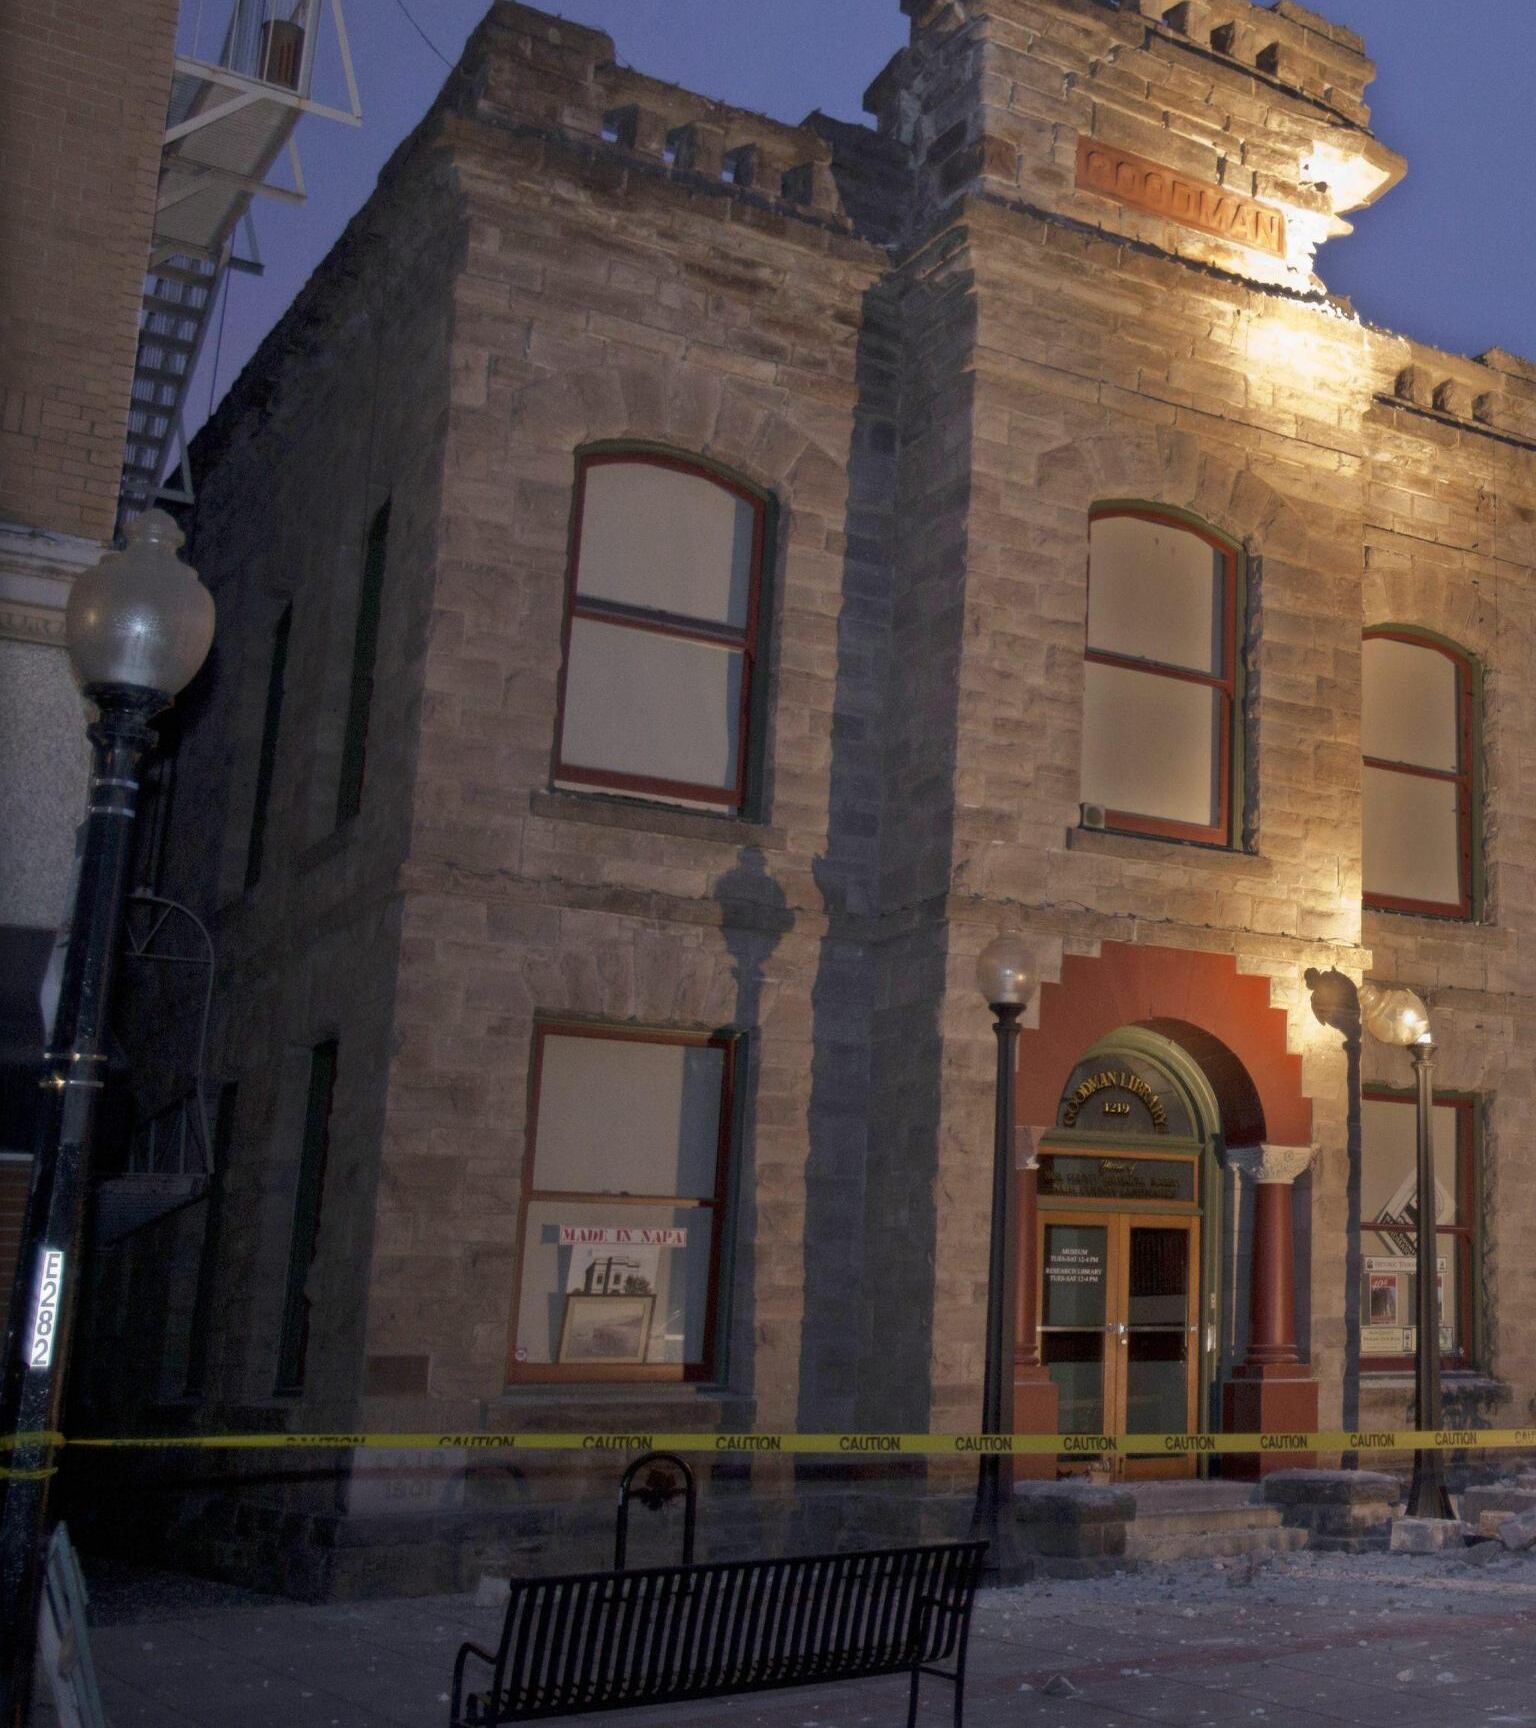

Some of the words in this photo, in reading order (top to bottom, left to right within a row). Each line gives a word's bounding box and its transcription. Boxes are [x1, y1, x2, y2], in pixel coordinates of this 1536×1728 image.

[1086, 150, 1282, 243] GOODMAN
[1063, 1071, 1118, 1128] GOODMAN
[1119, 1071, 1168, 1134] LIBRARY
[1103, 1102, 1130, 1114] 1219
[563, 1228, 608, 1242] MADE
[616, 1229, 632, 1243] IN
[641, 1230, 684, 1244] NAPA
[31, 1253, 60, 1366] E282
[583, 1437, 652, 1450] CAUTION
[715, 1436, 781, 1450] CAUTION
[840, 1436, 901, 1450] CAUTION
[955, 1436, 1013, 1450] CAUTION
[1063, 1436, 1117, 1450] CAUTION
[1165, 1436, 1215, 1450] CAUTION
[1260, 1435, 1308, 1449] CAUTION
[1350, 1434, 1395, 1448] CAUTION
[1435, 1432, 1478, 1446] CAUTION
